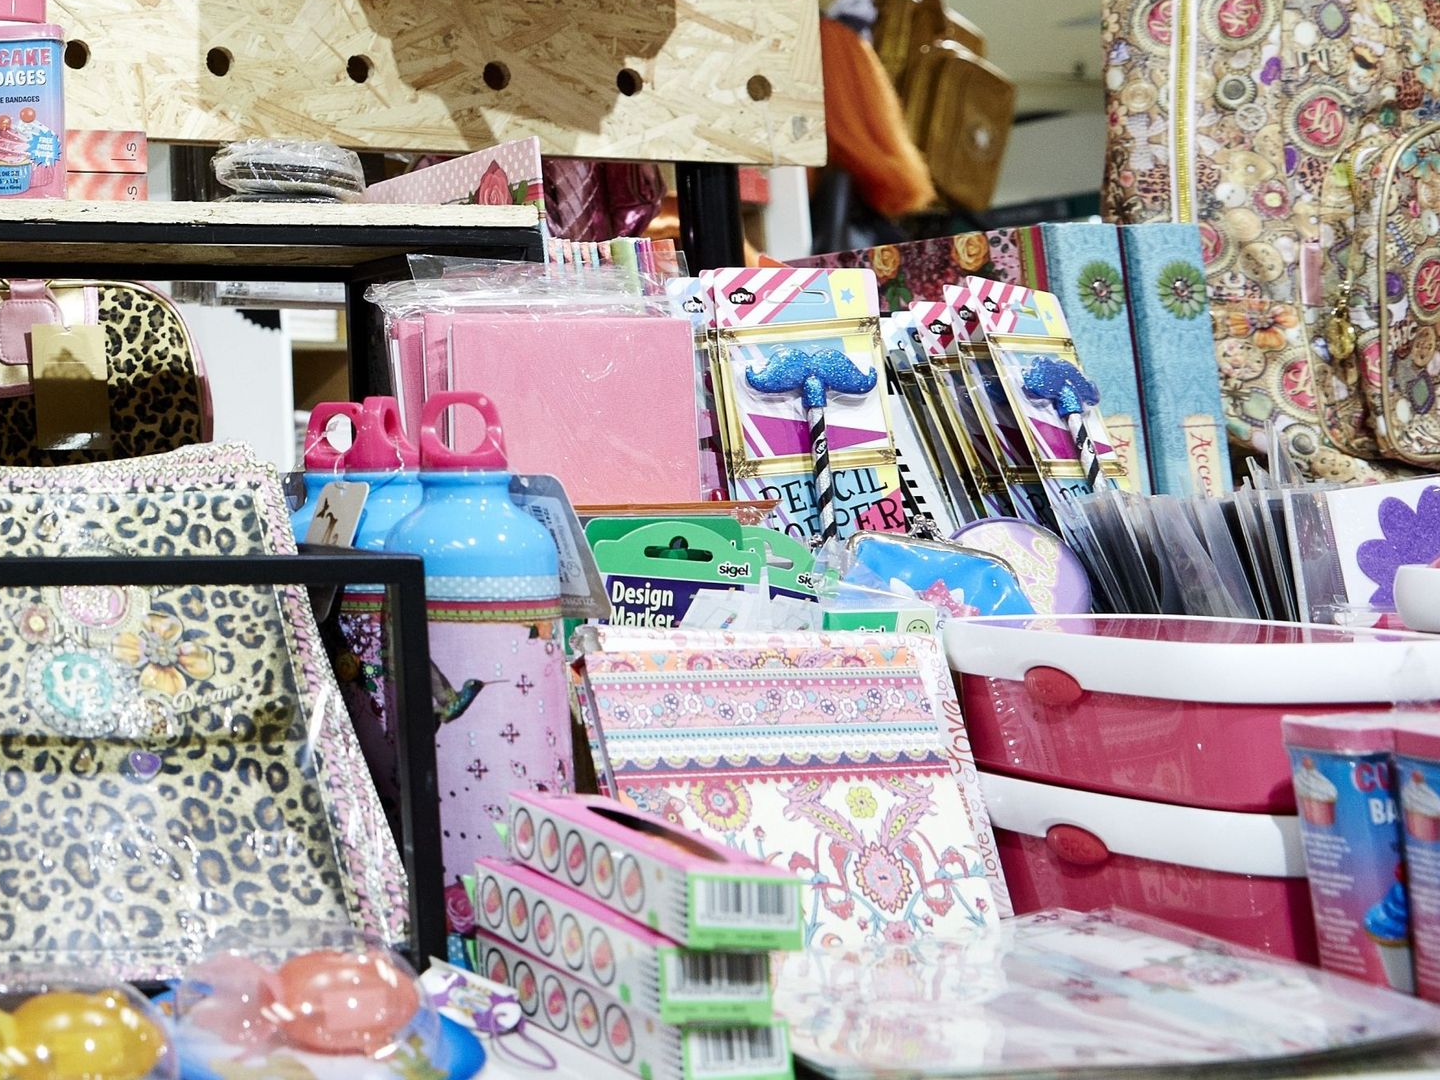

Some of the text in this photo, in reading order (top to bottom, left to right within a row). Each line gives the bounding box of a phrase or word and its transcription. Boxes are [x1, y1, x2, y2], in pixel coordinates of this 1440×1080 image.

[5, 95, 40, 104] BANDAGES
[718, 564, 750, 578] sigel
[611, 581, 674, 607] Design
[609, 607, 675, 628] Marker
